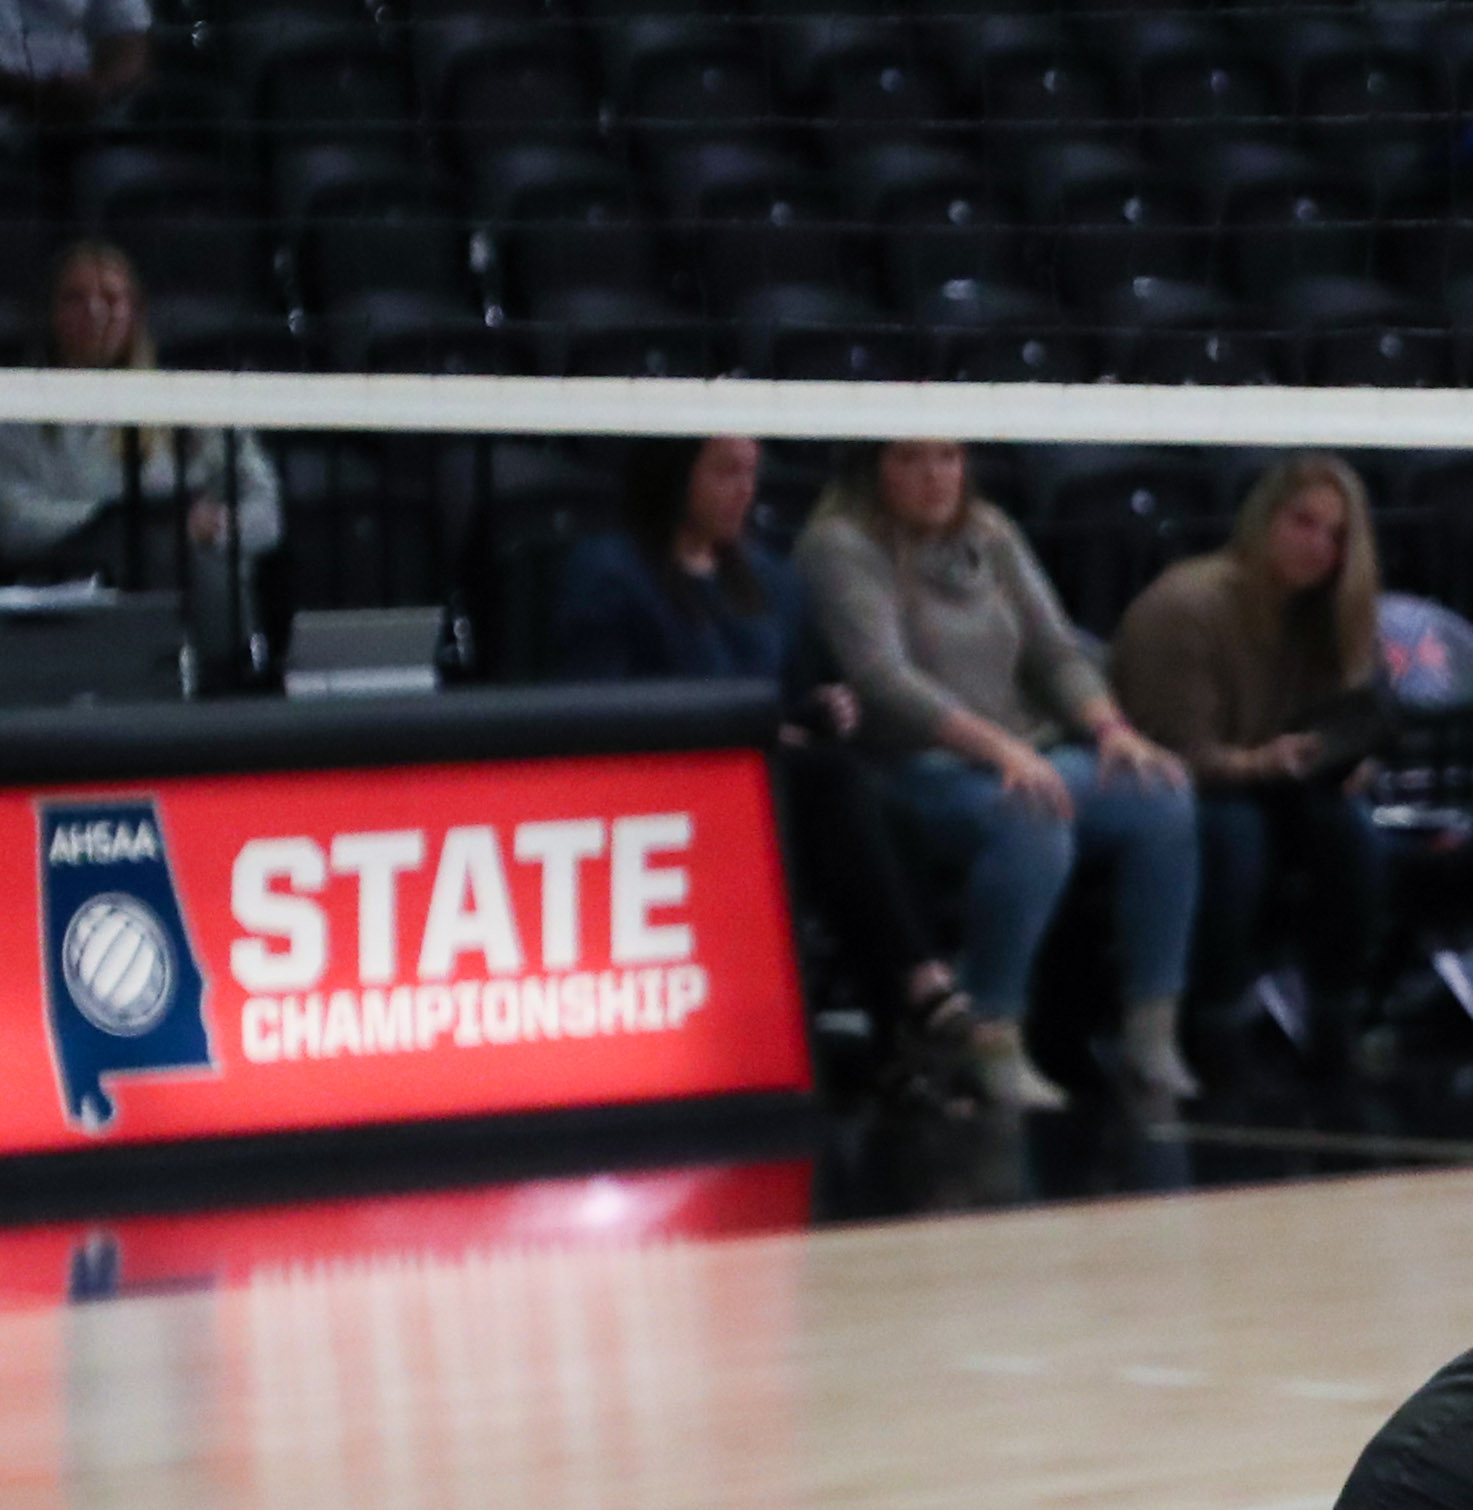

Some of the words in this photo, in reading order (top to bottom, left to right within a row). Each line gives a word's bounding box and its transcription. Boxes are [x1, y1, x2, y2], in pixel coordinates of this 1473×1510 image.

[49, 818, 158, 867] AHSAA
[228, 811, 695, 993] STATE
[240, 965, 712, 1064] CHAMPIONSHIP
